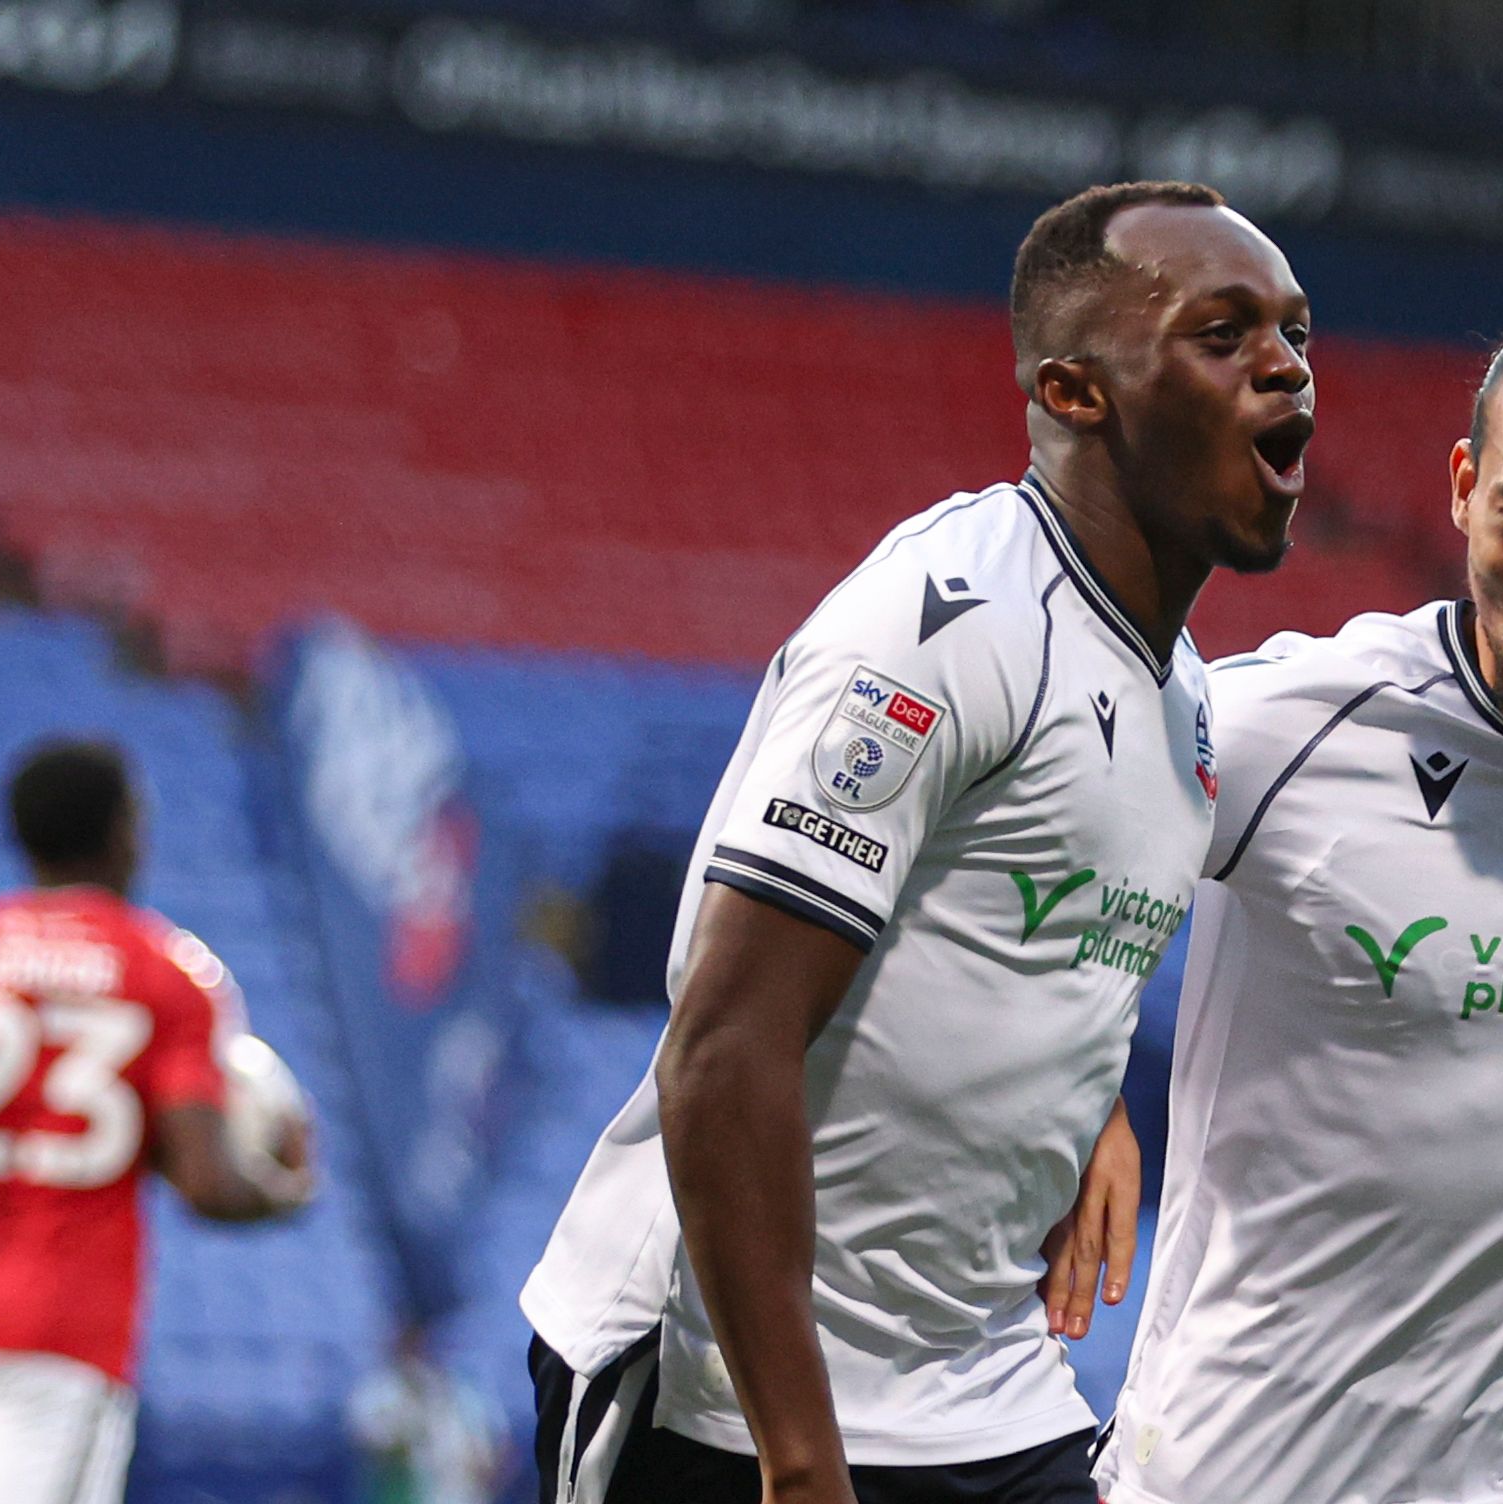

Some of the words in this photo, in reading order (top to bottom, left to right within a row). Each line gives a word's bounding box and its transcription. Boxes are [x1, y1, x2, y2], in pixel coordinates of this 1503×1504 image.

[844, 702, 891, 734] LEAGUE
[893, 727, 922, 750] ONE
[852, 678, 890, 707] sky
[892, 694, 929, 728] bet
[832, 771, 861, 800] EFL
